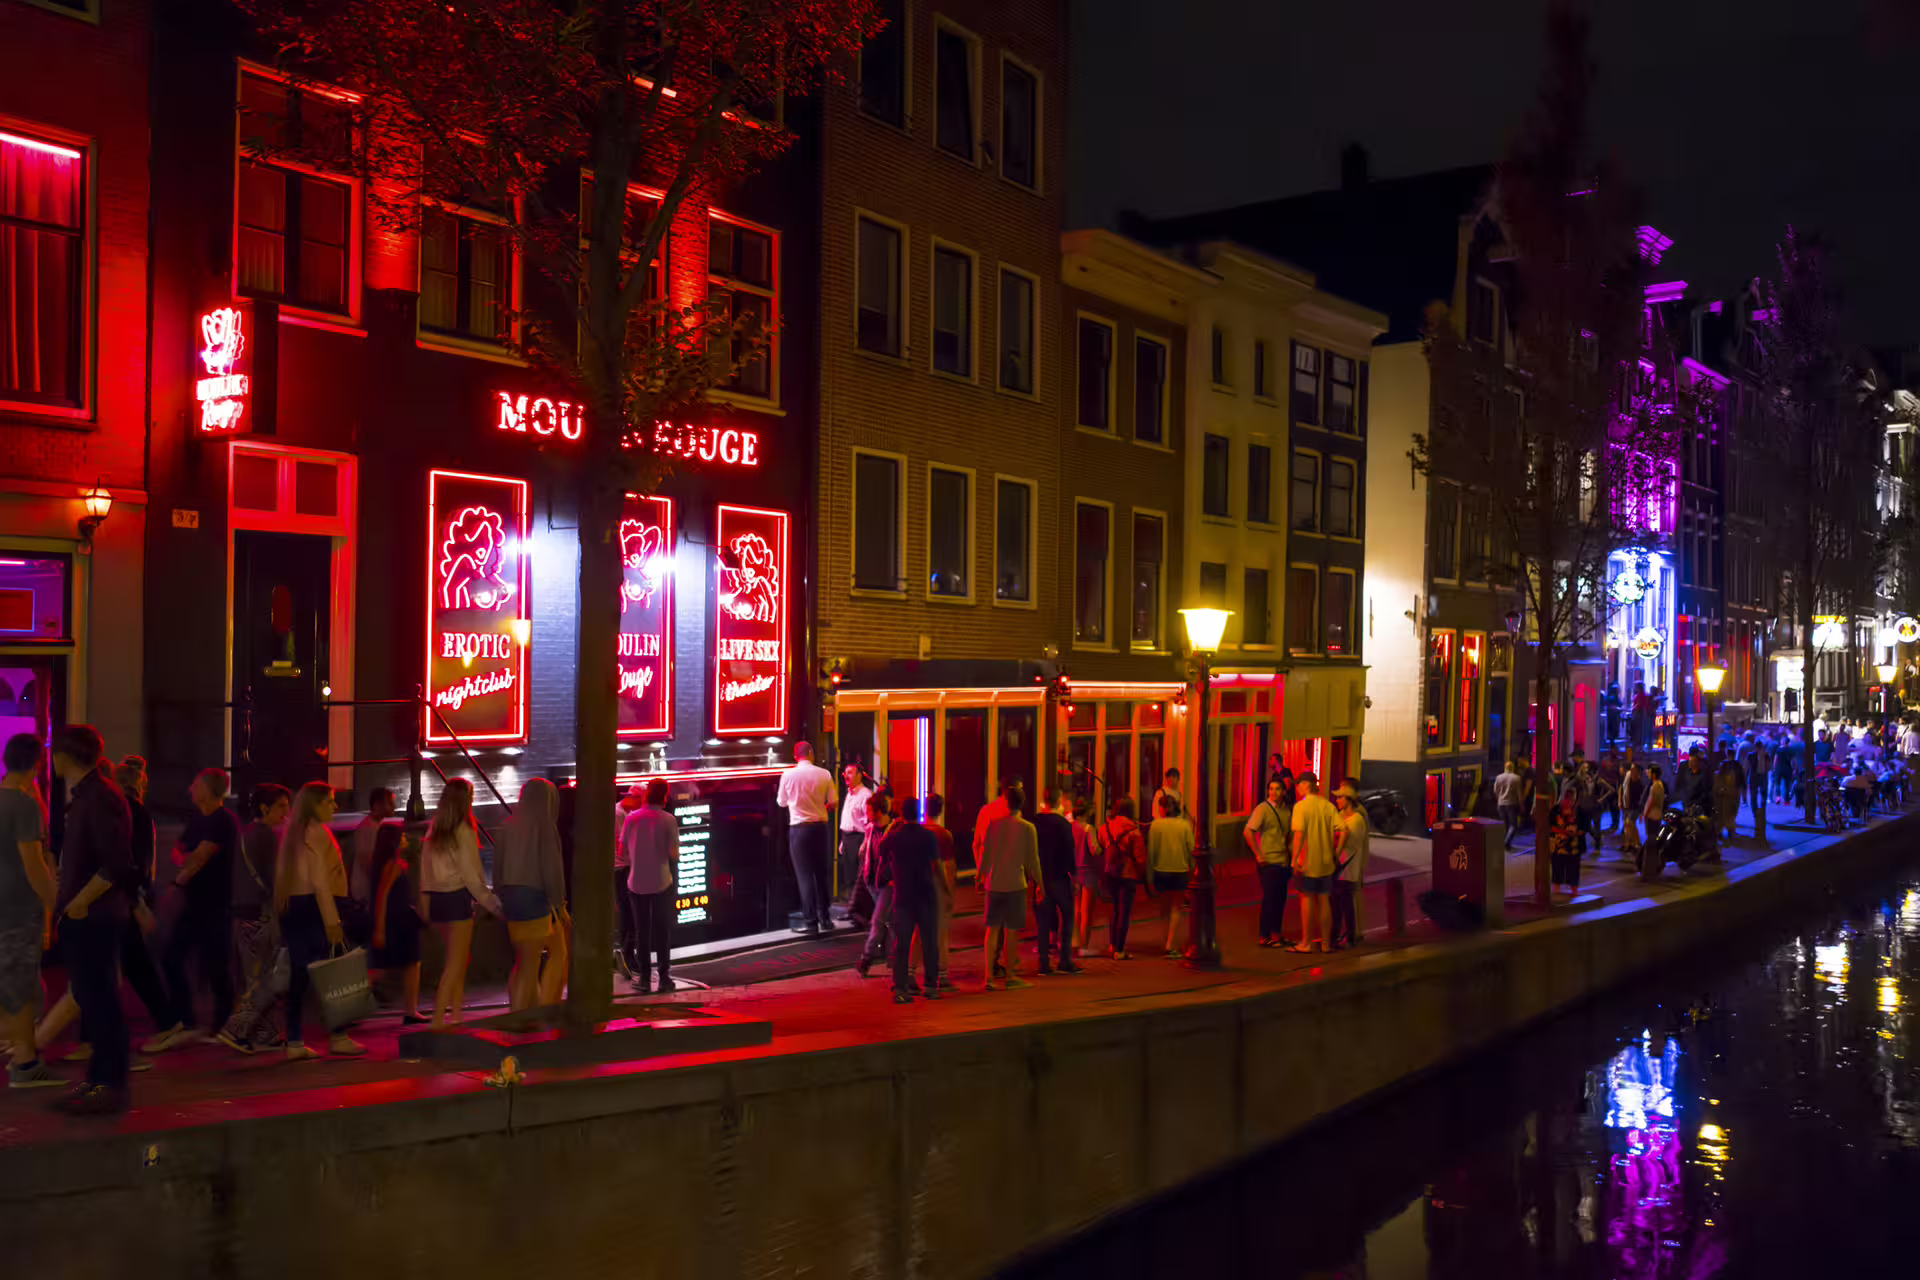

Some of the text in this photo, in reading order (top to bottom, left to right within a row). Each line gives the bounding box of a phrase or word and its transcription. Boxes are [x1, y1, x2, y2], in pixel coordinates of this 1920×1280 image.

[442, 632, 511, 659] EROTIC
[617, 633, 660, 657] ULIN
[435, 668, 516, 710] nightclub
